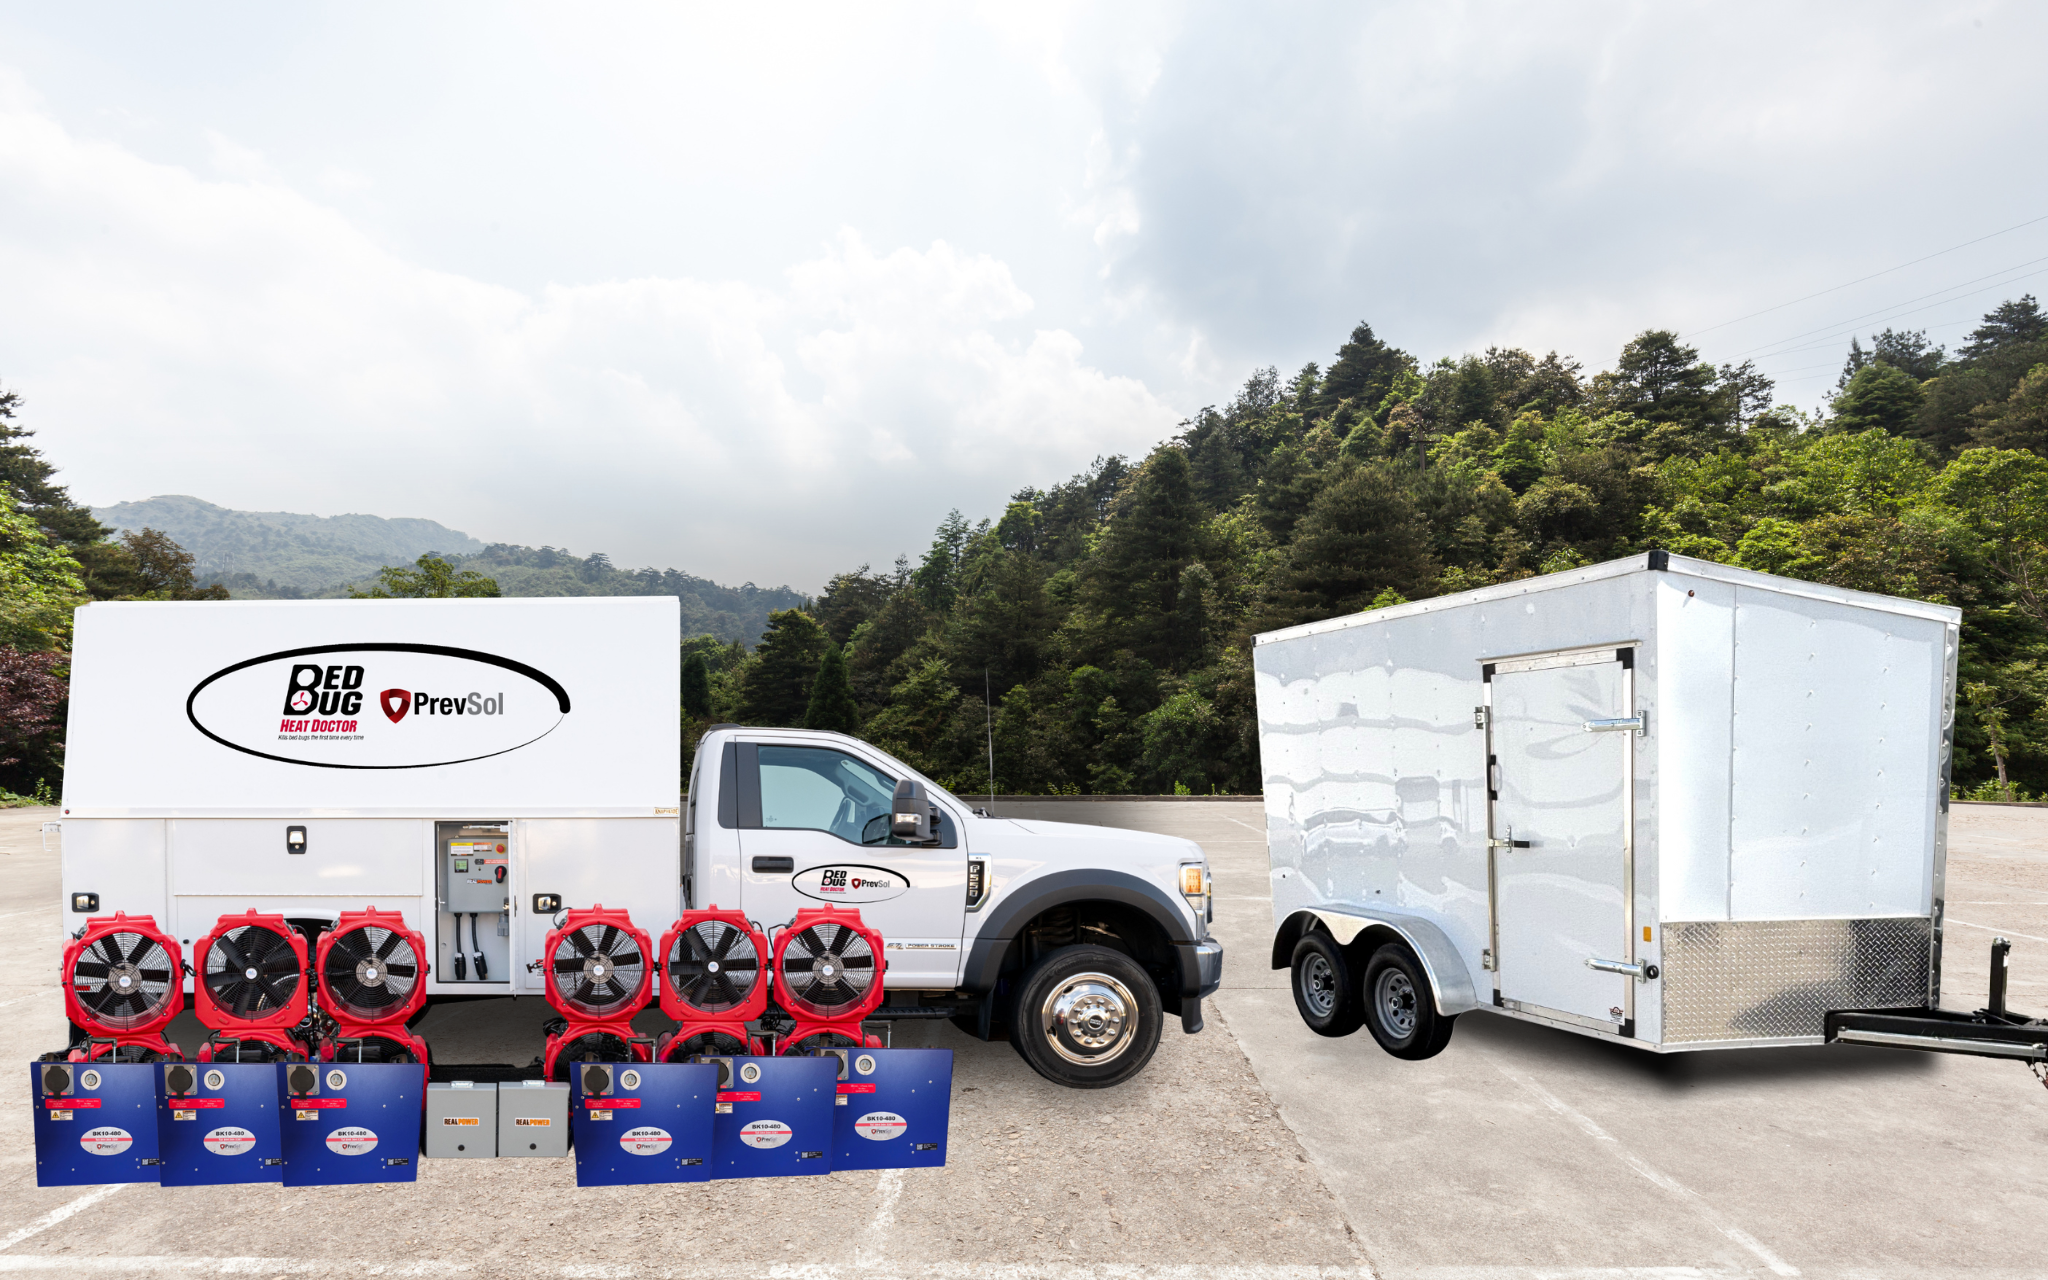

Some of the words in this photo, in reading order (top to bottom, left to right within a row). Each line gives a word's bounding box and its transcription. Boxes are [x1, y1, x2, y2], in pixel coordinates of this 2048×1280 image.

[283, 664, 364, 693] BED
[283, 690, 363, 716] BUG
[414, 692, 503, 715] PrevSol
[280, 719, 310, 732] HEAT
[311, 719, 357, 732] DOCTOR
[821, 870, 847, 880] BED
[861, 880, 890, 888] PrevSol
